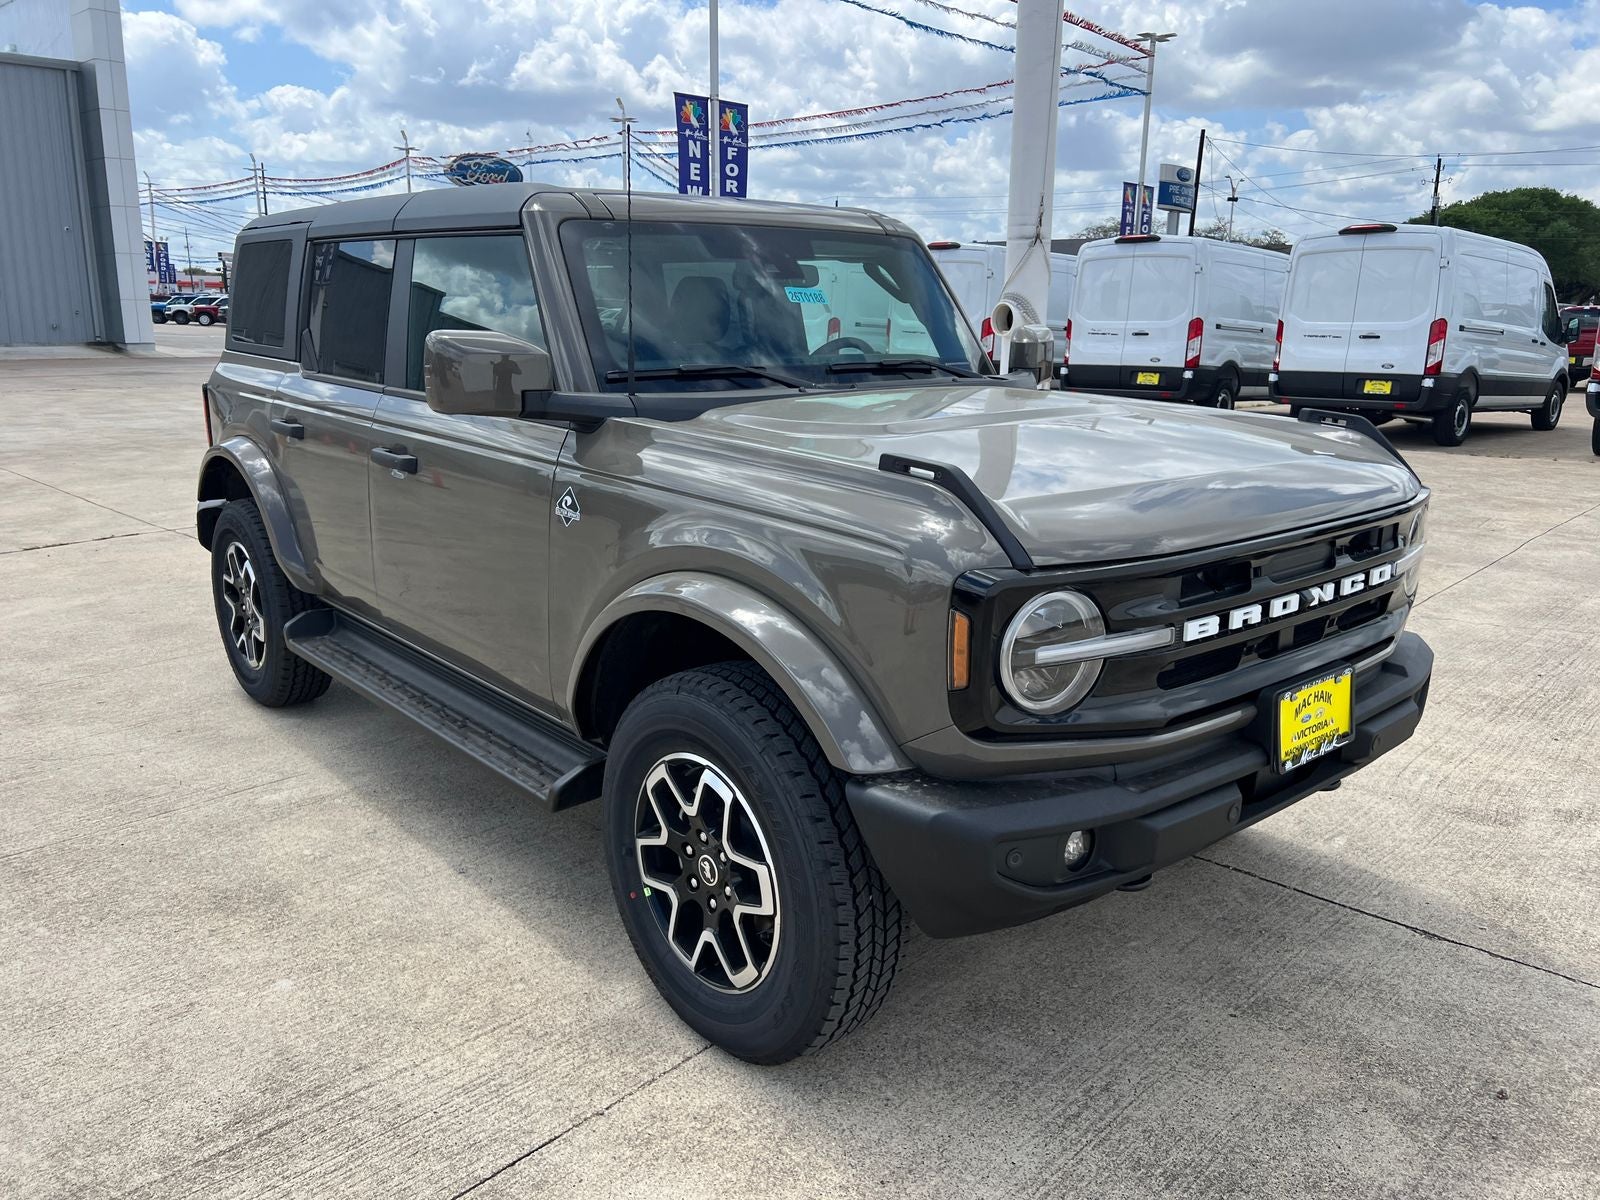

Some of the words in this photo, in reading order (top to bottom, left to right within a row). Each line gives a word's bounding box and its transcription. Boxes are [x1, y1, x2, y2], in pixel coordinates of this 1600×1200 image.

[466, 160, 510, 184] Ford
[686, 139, 703, 196] NEW
[1183, 563, 1392, 642] BRONCO
[1294, 692, 1312, 721] MAC
[1313, 689, 1333, 705] HAIK
[1296, 719, 1329, 741] VICTORIA
